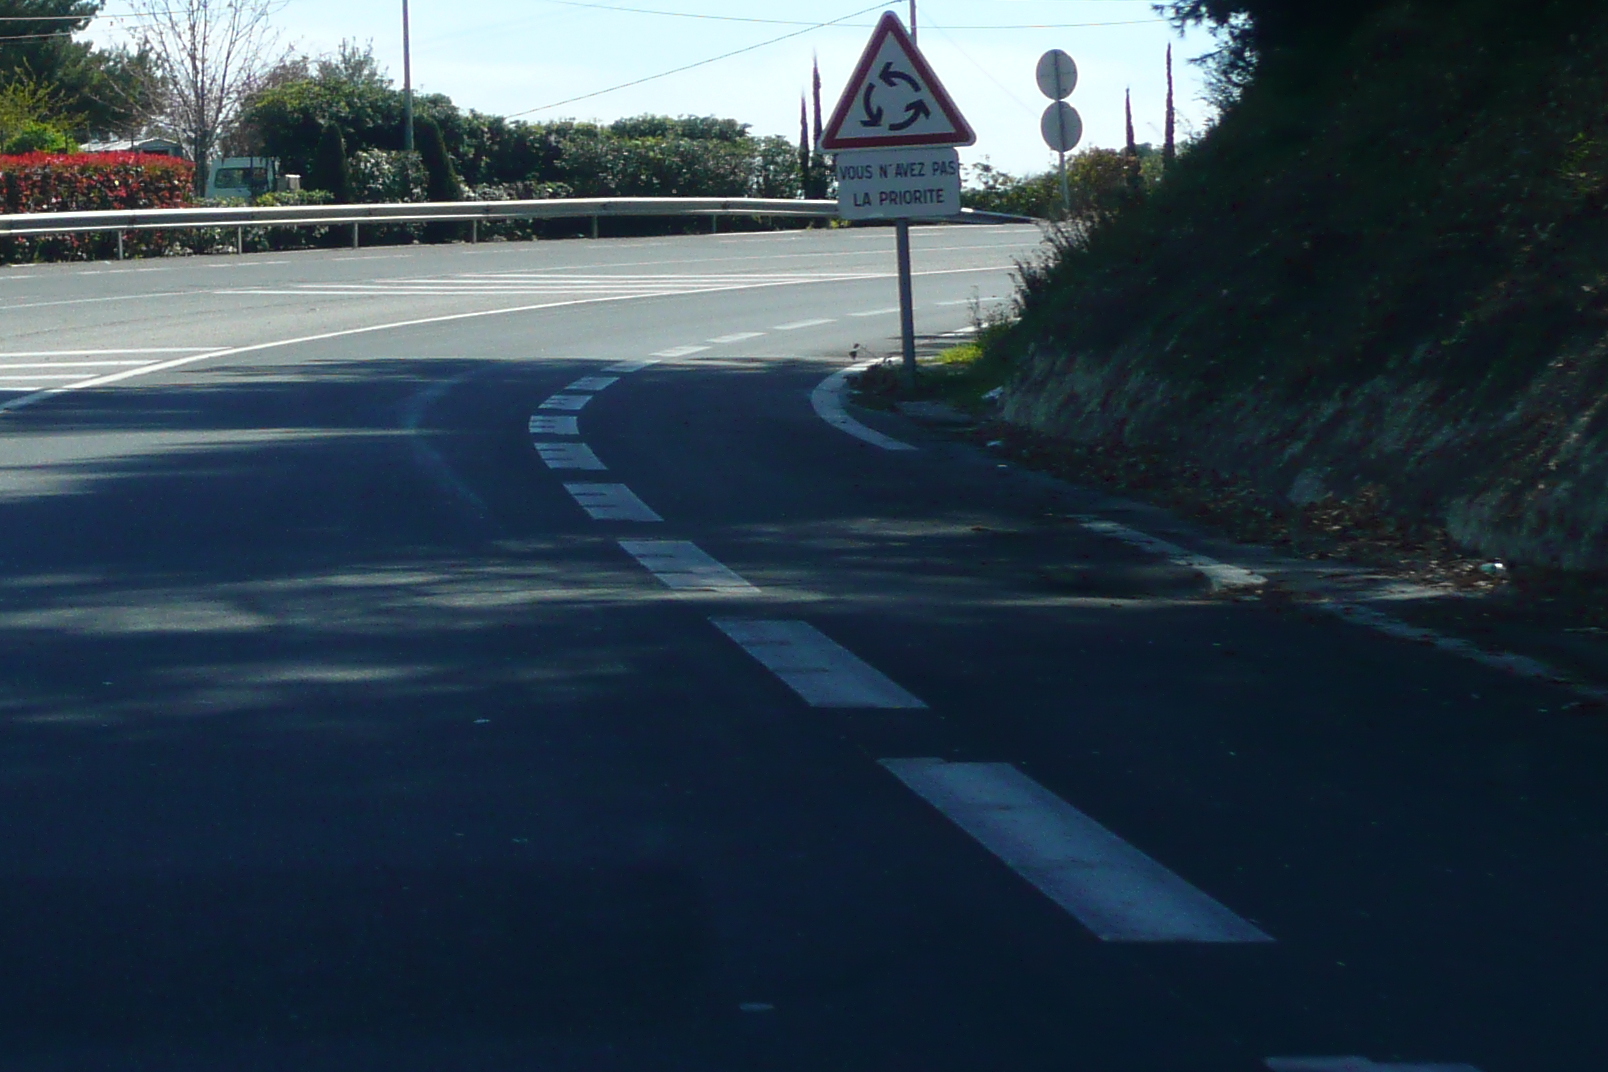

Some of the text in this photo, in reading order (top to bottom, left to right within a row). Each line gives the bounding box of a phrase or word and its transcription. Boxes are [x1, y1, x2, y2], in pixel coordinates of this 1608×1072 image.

[839, 165, 873, 180] VOUS
[932, 160, 956, 176] PAS
[853, 188, 945, 207] LA PRIORITE
